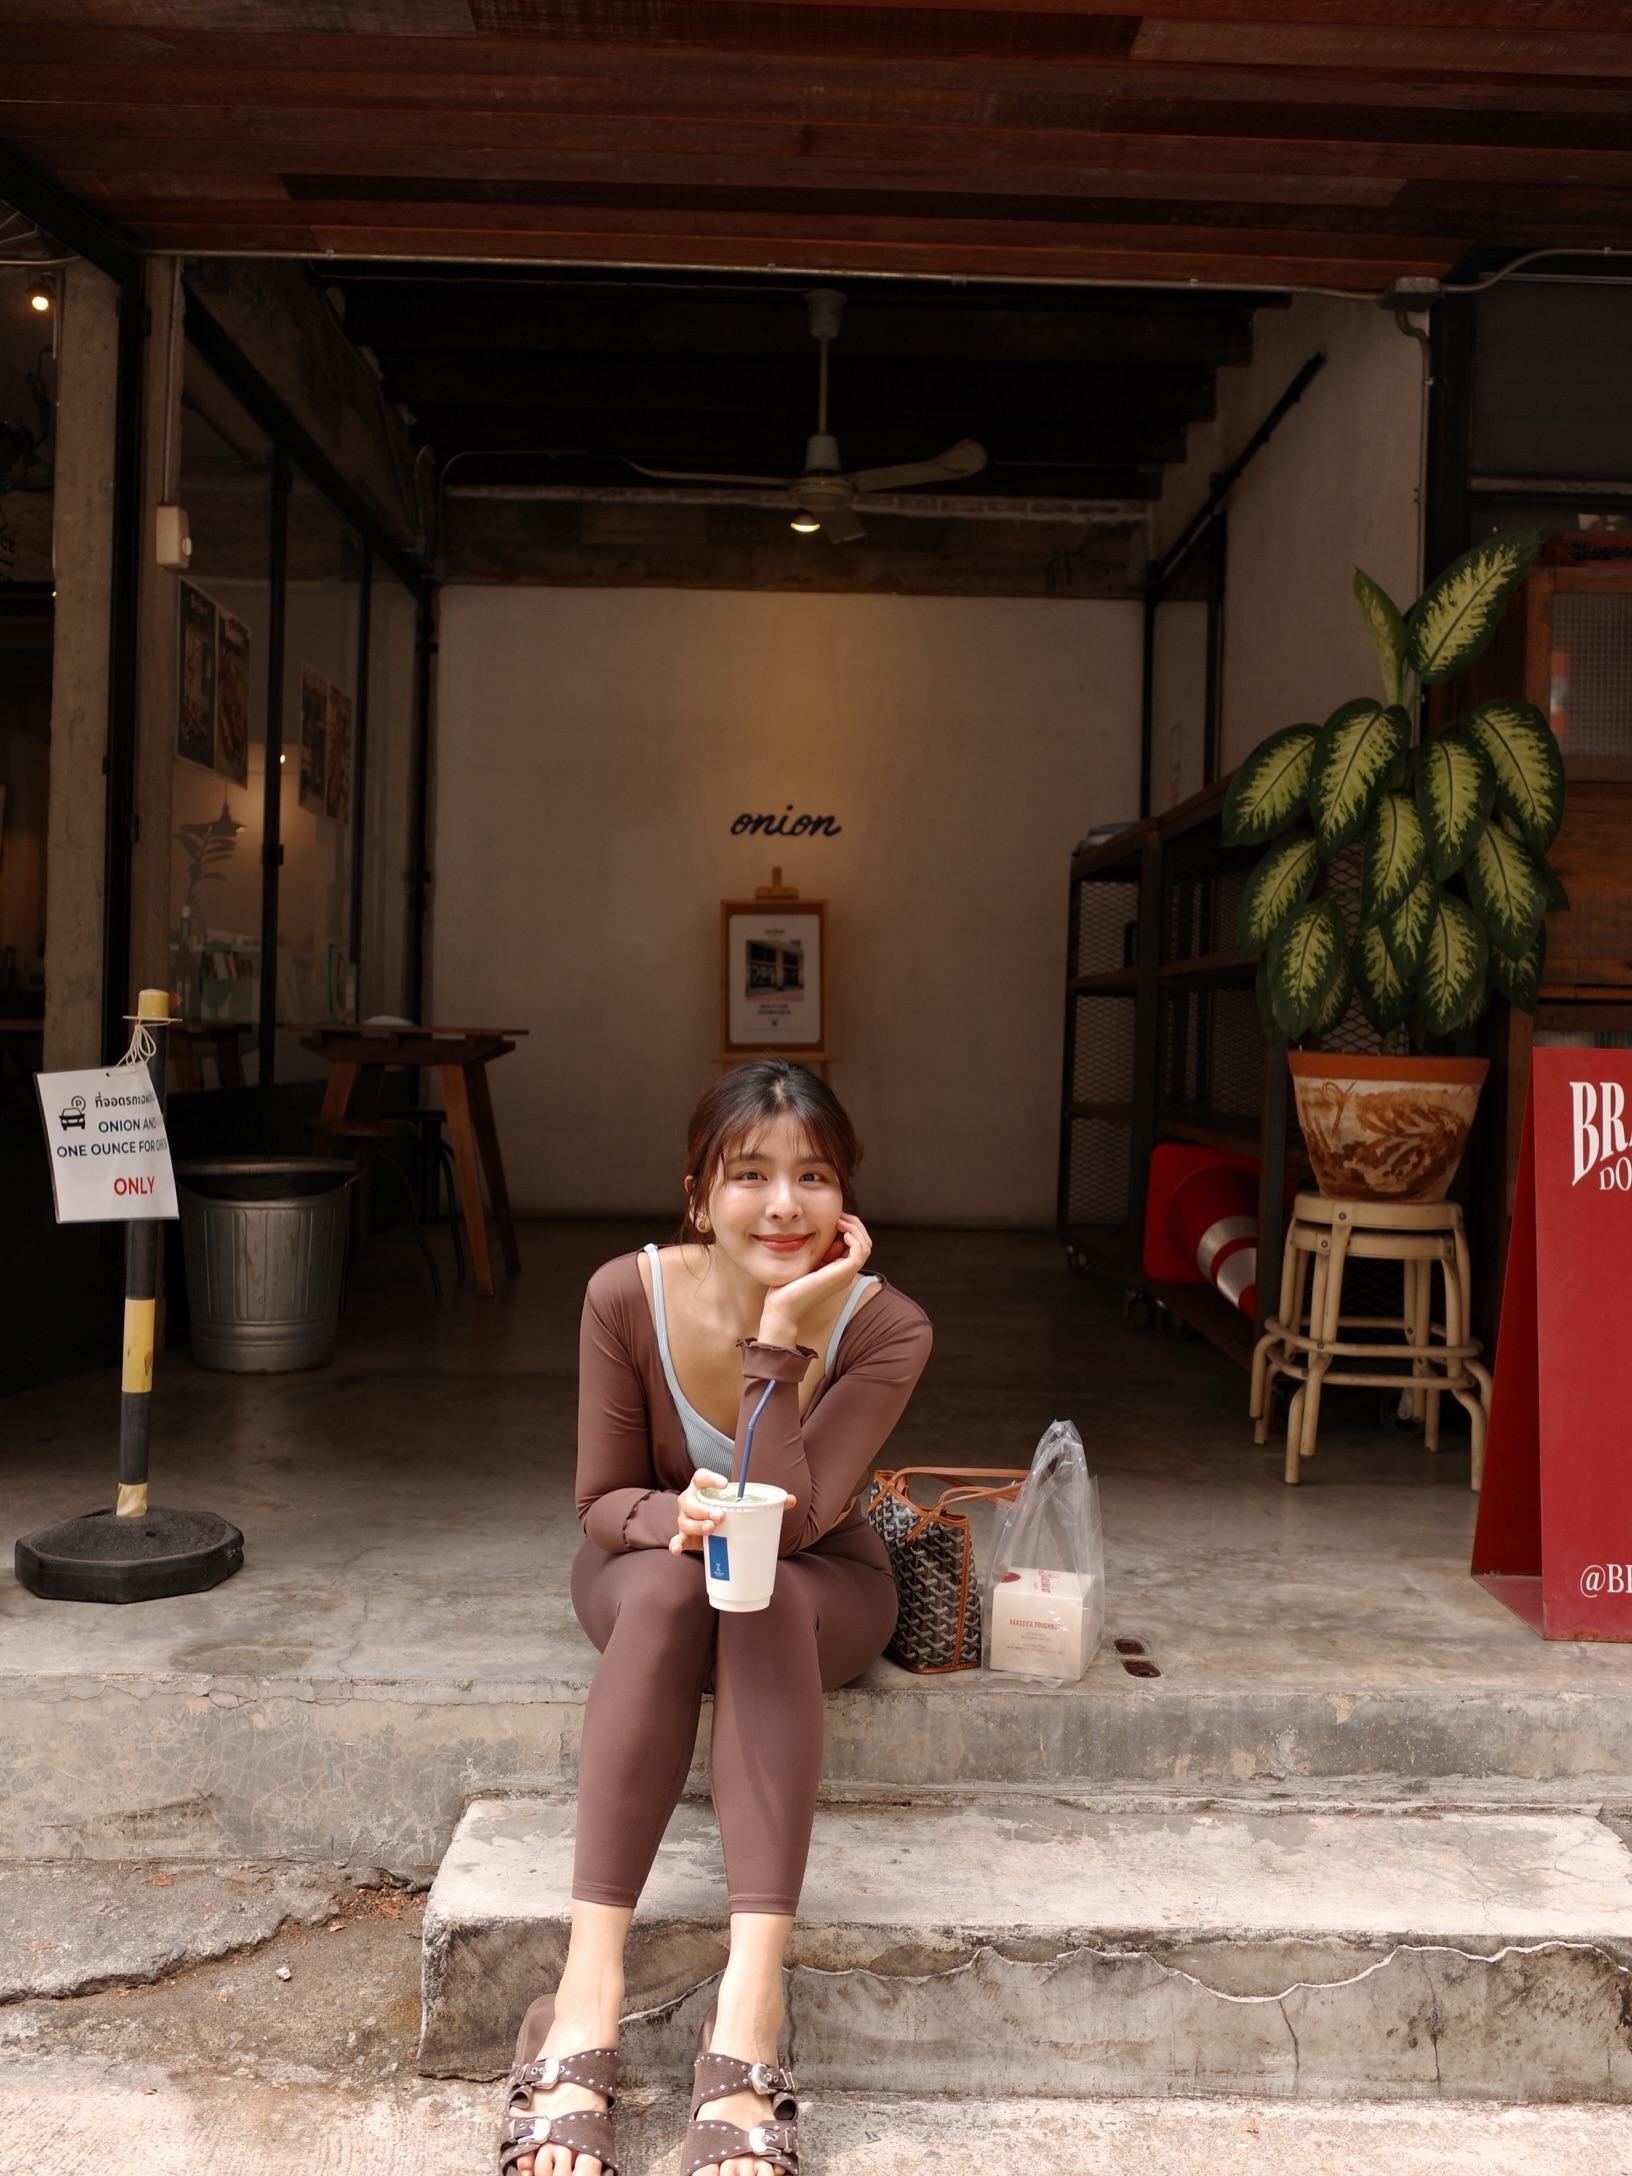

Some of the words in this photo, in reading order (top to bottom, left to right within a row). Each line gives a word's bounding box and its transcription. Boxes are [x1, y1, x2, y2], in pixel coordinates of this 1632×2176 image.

[730, 804, 841, 836] onion
[98, 1119, 140, 1133] ONION
[142, 1117, 157, 1131] AND
[1570, 1081, 1632, 1186] BR
[57, 1145, 88, 1157] ONE
[90, 1140, 137, 1156] OUNCE
[138, 1139, 155, 1153] FOR
[114, 1176, 155, 1195] ONLY
[1009, 1618, 1034, 1629] BRASSICA
